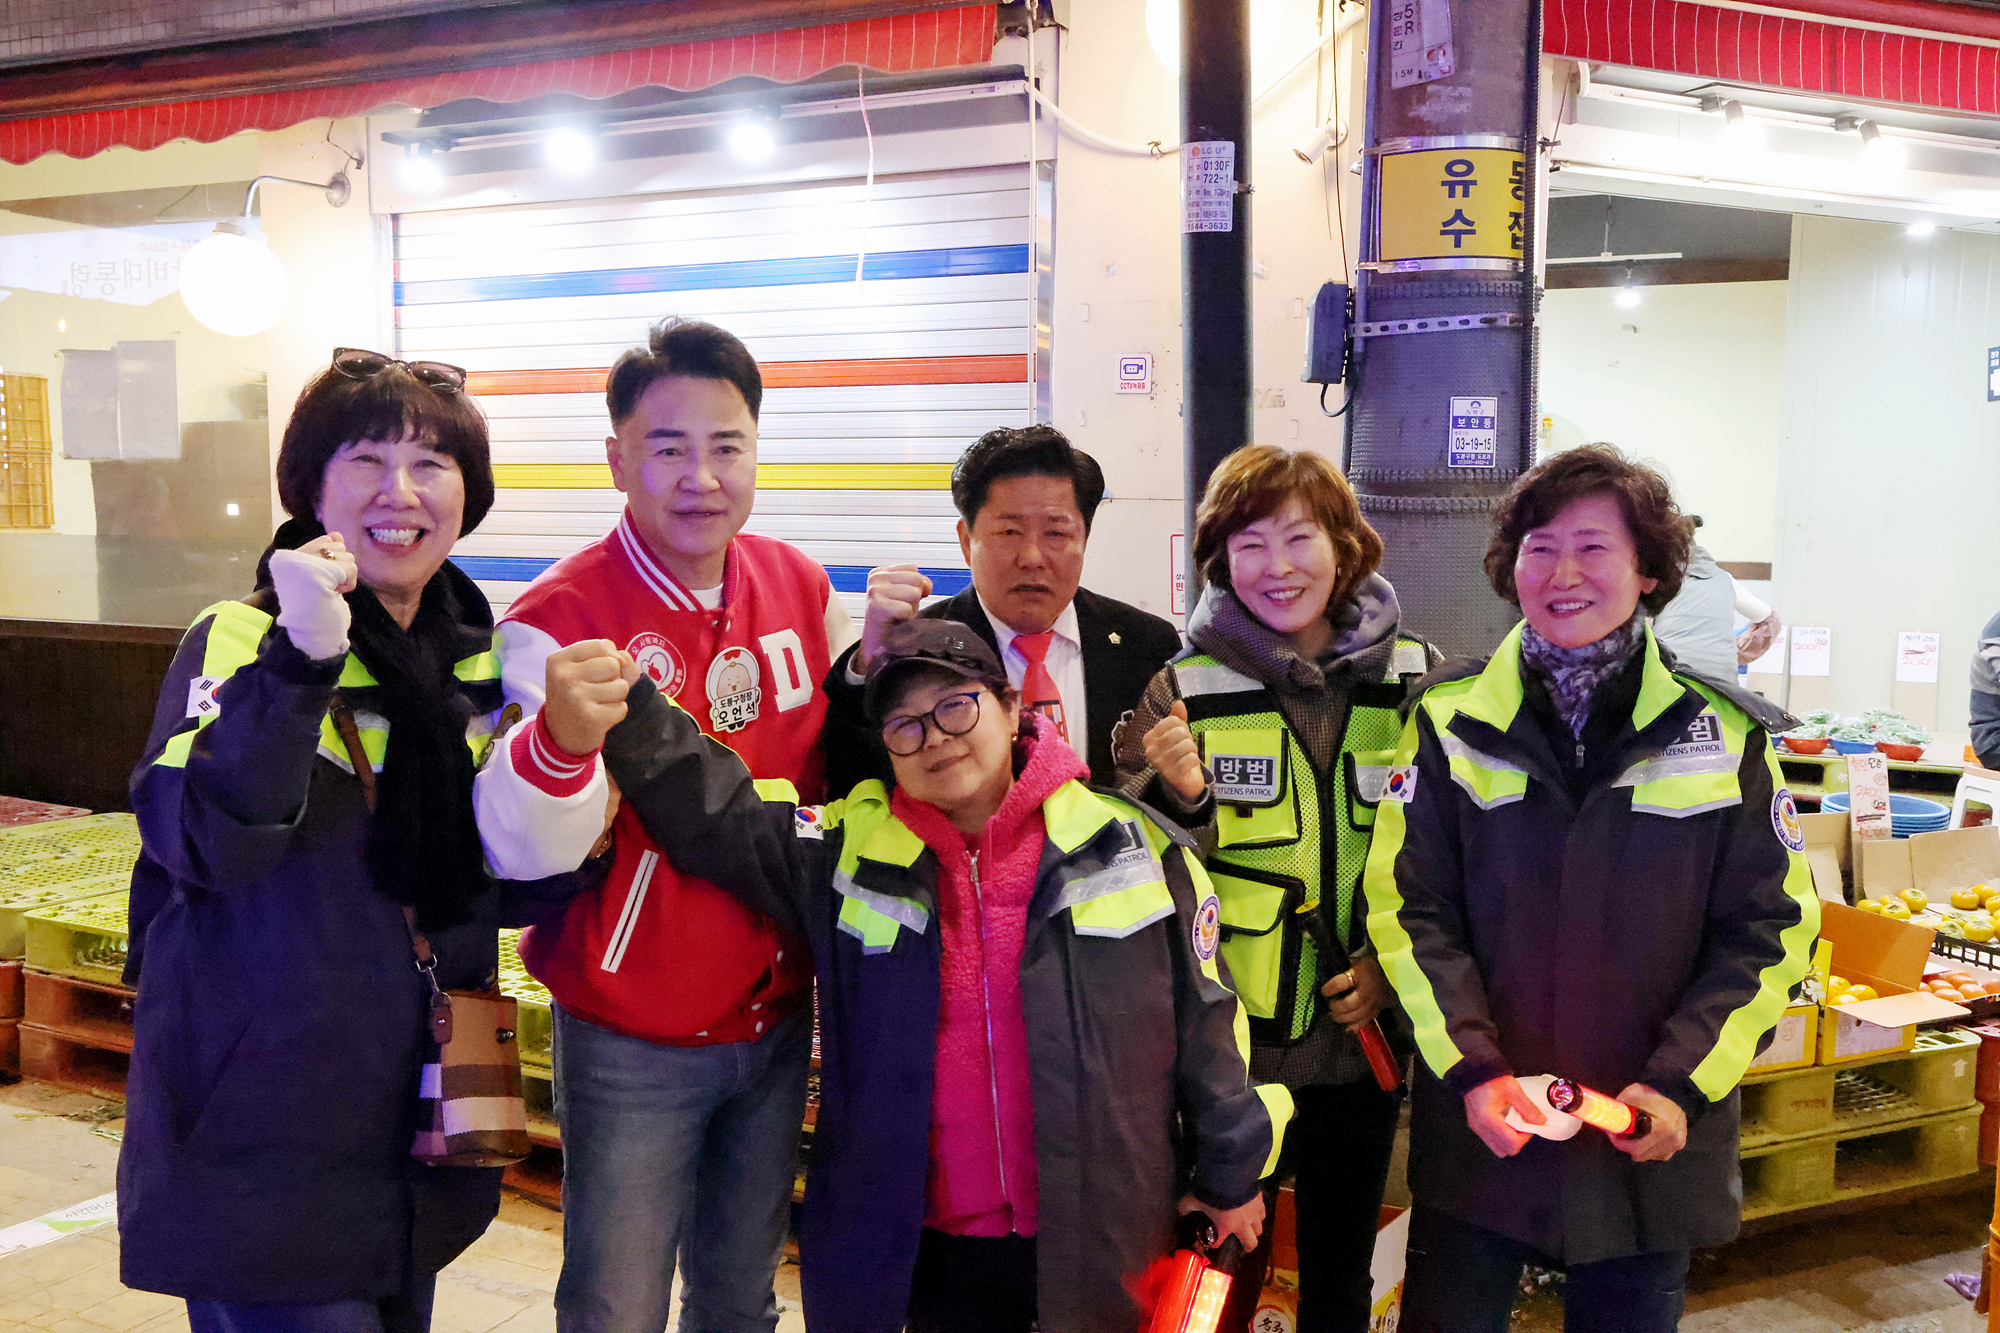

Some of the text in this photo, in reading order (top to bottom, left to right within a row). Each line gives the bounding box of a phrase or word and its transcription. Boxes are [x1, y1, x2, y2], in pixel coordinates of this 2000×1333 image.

[1203, 160, 1230, 171] 0130F
[1203, 173, 1229, 184] 722-1
[1187, 222, 1228, 231] 1544-3633
[1455, 437, 1492, 451] 03-19-15
[1794, 642, 1823, 651] 2000
[1902, 656, 1936, 668] 2000
[758, 628, 814, 713] D
[720, 691, 753, 709] 도봉구청장
[1689, 744, 1722, 754] PATROL
[1220, 758, 1267, 785] 방범
[1214, 786, 1273, 797] CITIZENS PATROL
[1119, 852, 1149, 866] PATROL
